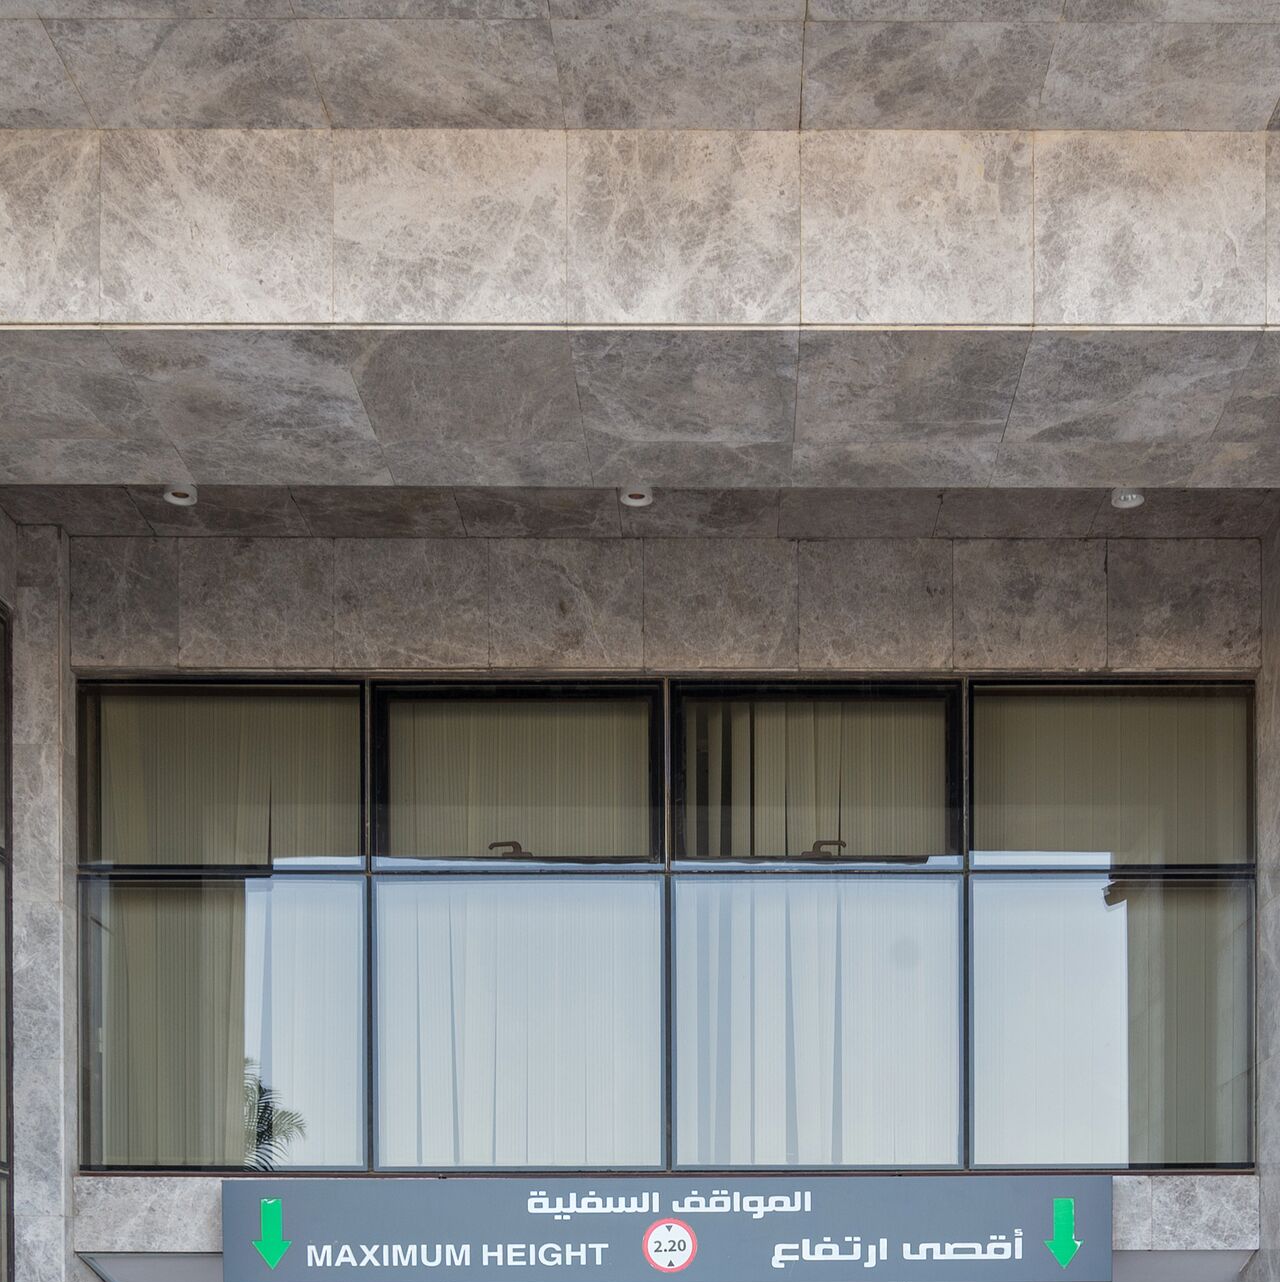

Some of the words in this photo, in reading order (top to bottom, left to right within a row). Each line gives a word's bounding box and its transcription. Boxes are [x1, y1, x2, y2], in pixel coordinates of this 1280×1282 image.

[527, 1190, 660, 1220] السفلية
[671, 1189, 812, 1219] المواقف
[306, 1243, 471, 1267] MAXIMUM
[482, 1242, 609, 1266] HEIGHT
[653, 1239, 687, 1253] 2.20
[771, 1236, 888, 1268] ارتفاع
[902, 1228, 1023, 1260] أقصى
